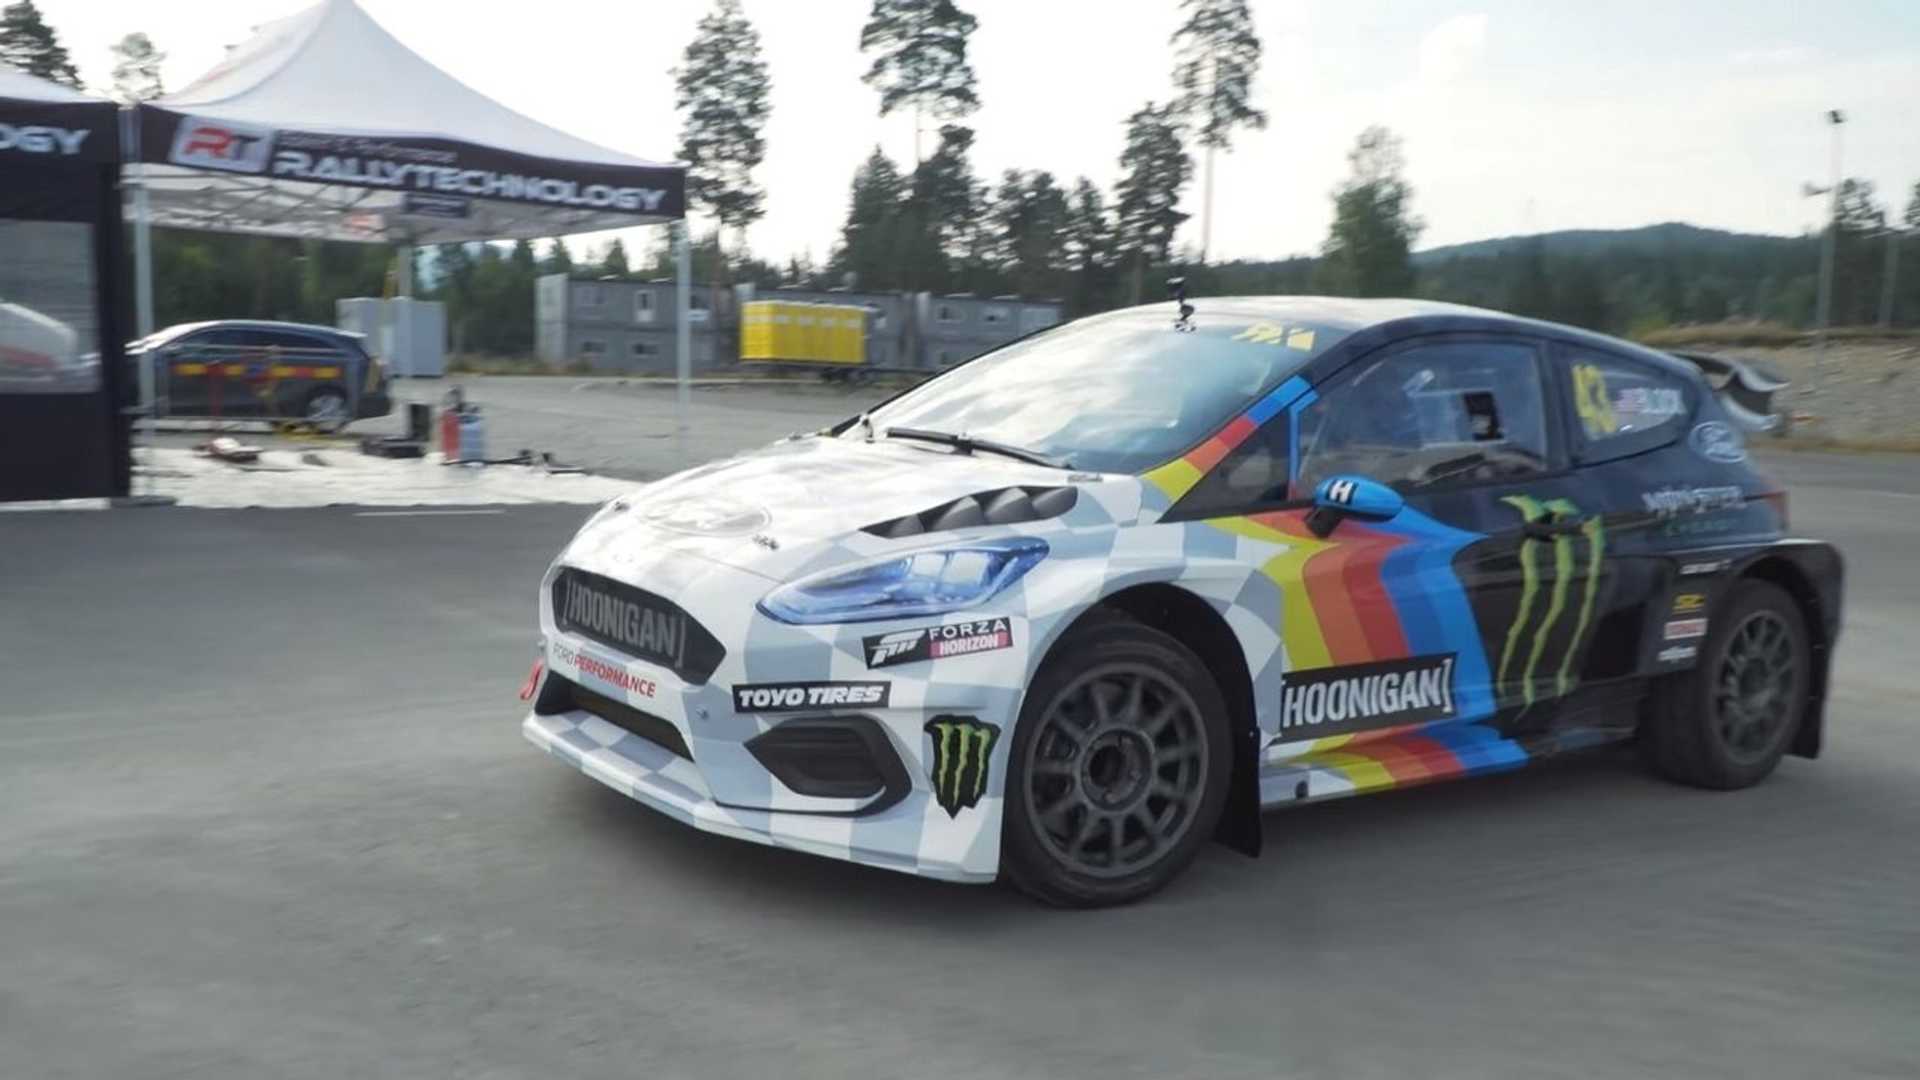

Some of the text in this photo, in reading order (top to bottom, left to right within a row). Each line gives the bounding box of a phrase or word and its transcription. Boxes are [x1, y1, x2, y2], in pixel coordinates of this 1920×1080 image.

[271, 149, 667, 211] RALLYTECHNOLOGY
[1328, 480, 1355, 504] H
[929, 620, 1008, 641] FORZA
[939, 634, 999, 656] HORIZON
[575, 655, 656, 699] PERFORMANCE
[739, 685, 885, 708] TOYO TIRES
